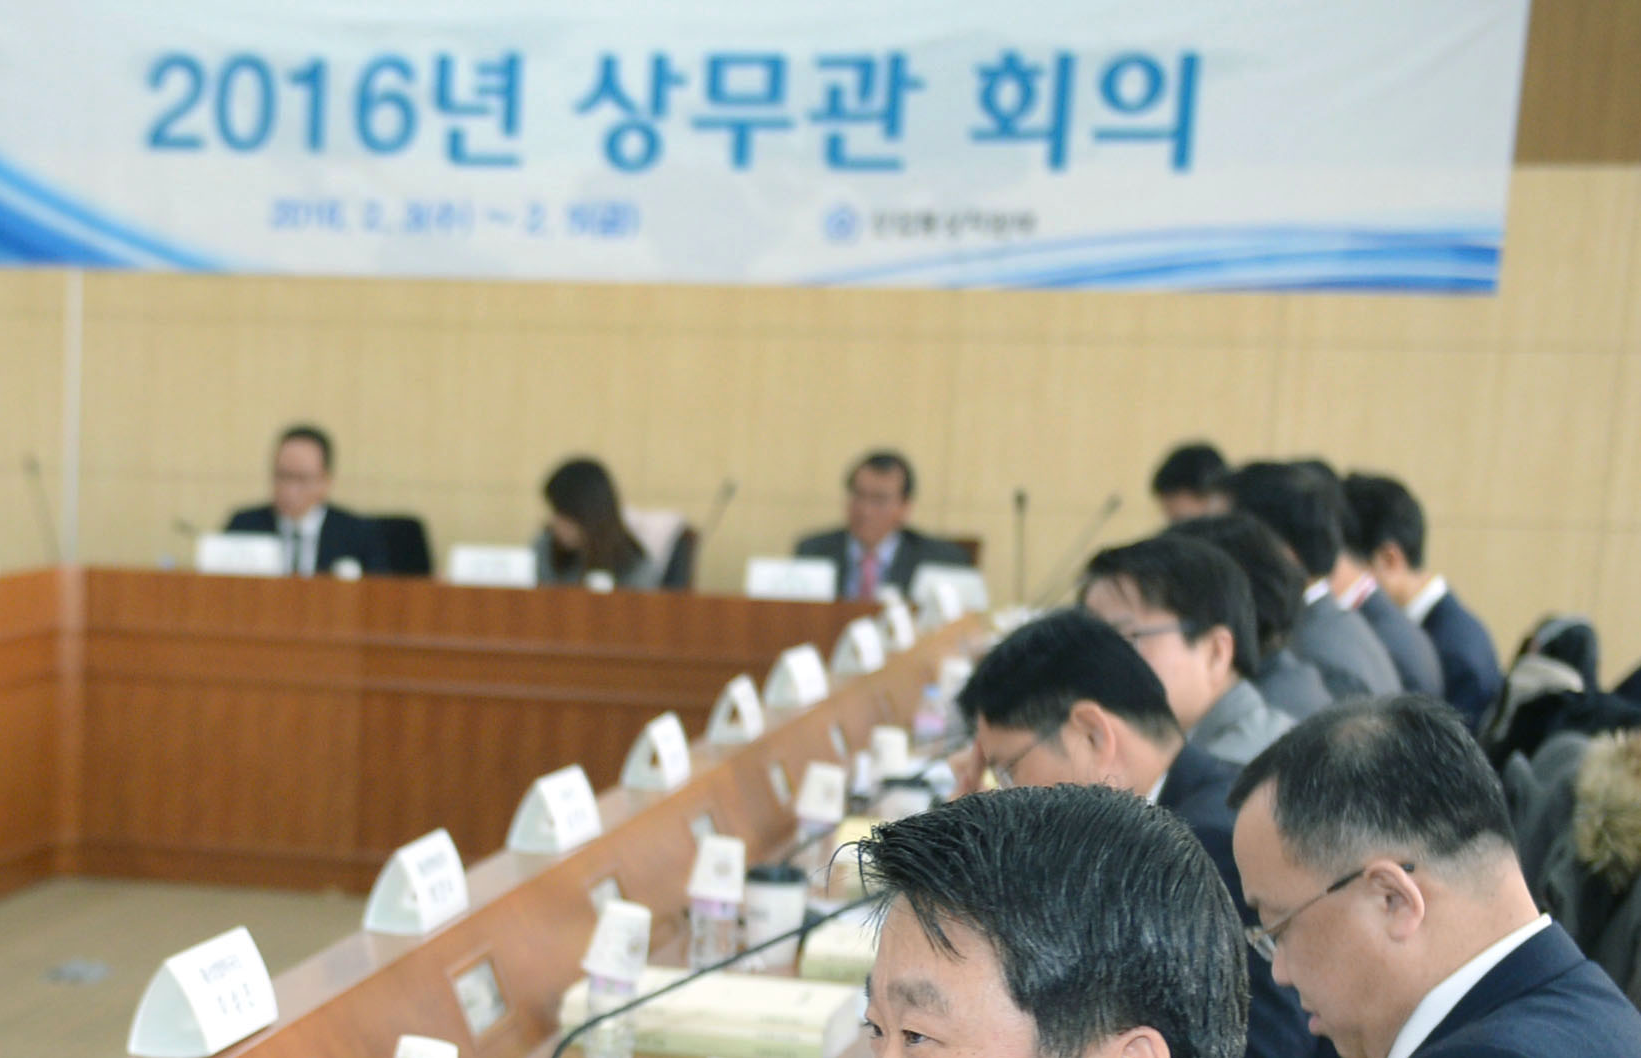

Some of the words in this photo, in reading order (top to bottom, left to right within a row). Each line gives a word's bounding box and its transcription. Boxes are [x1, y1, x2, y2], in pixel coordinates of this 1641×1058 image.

[145, 51, 524, 168] 2016년
[573, 50, 926, 172] 상무관
[968, 49, 1201, 172] 회의
